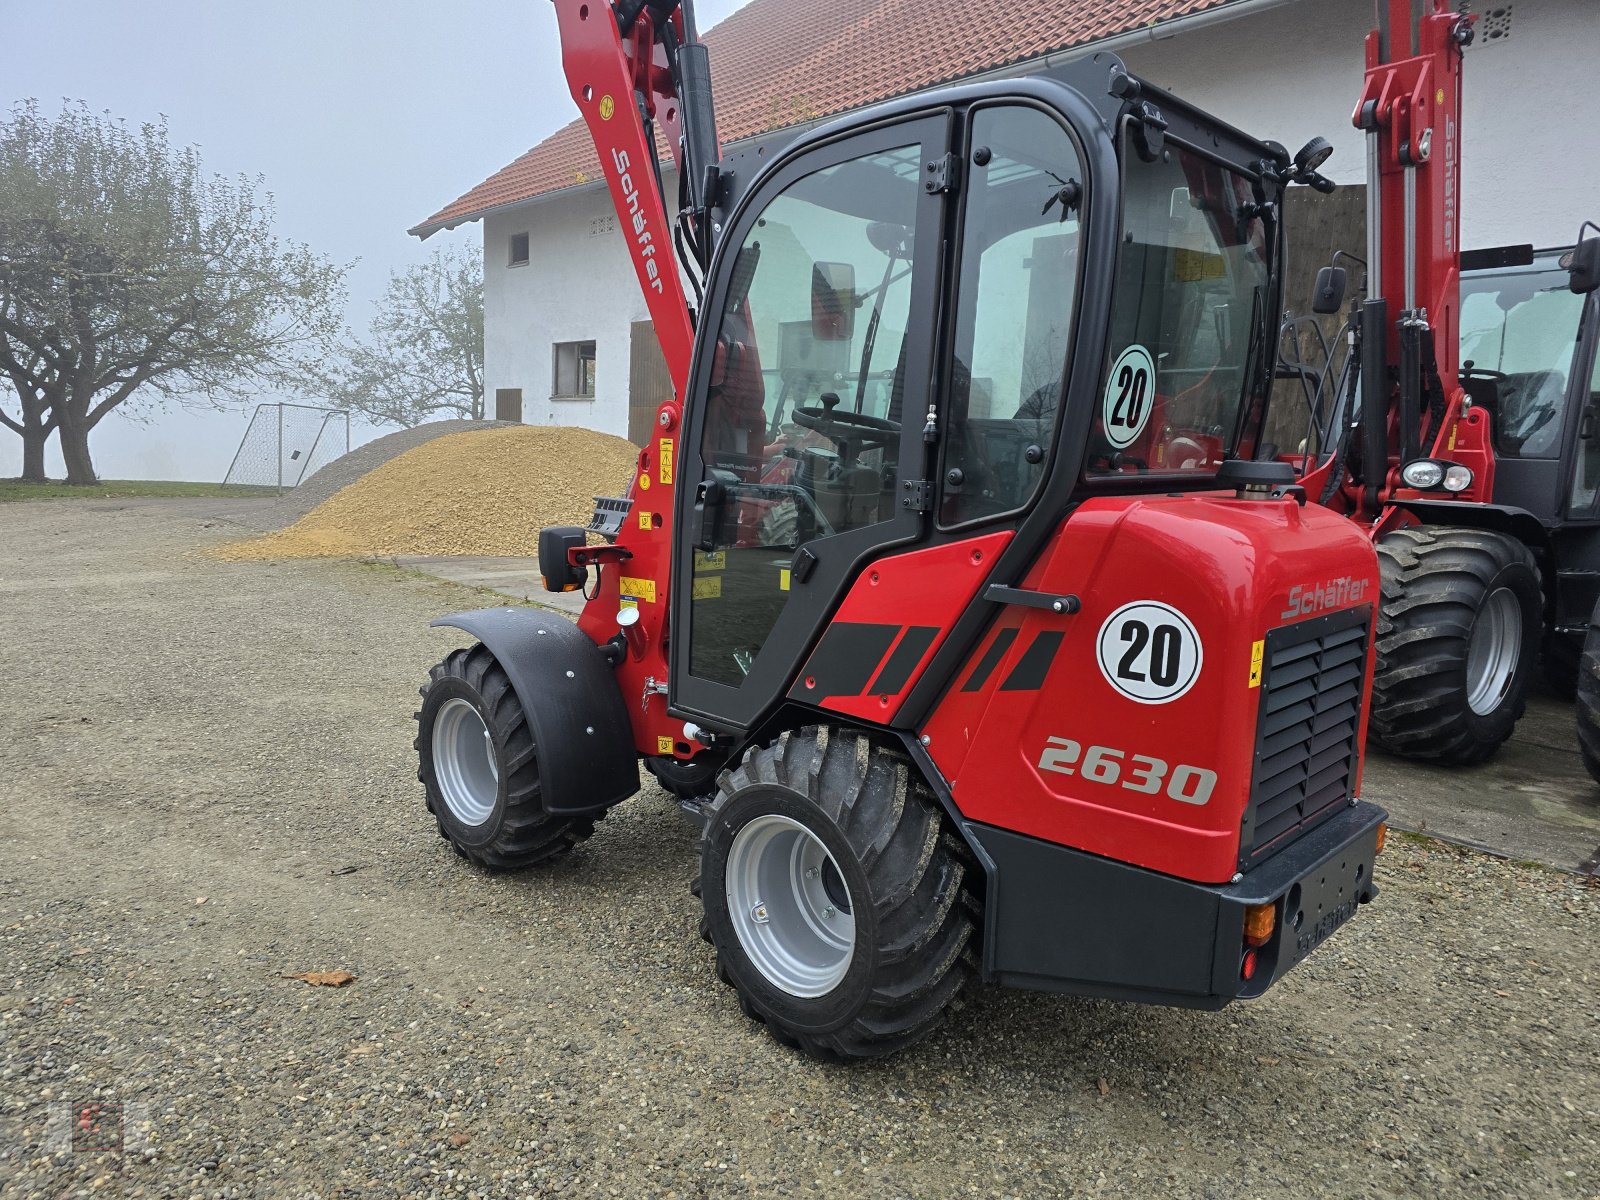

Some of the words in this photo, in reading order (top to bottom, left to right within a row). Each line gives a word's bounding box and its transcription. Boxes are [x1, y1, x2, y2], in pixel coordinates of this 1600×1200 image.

[1444, 113, 1455, 253] Schäffer
[611, 147, 664, 295] Schäffer
[1110, 365, 1148, 429] 20
[1281, 575, 1369, 620] Schäffer
[1117, 619, 1182, 688] 20
[1038, 735, 1219, 806] 2630
